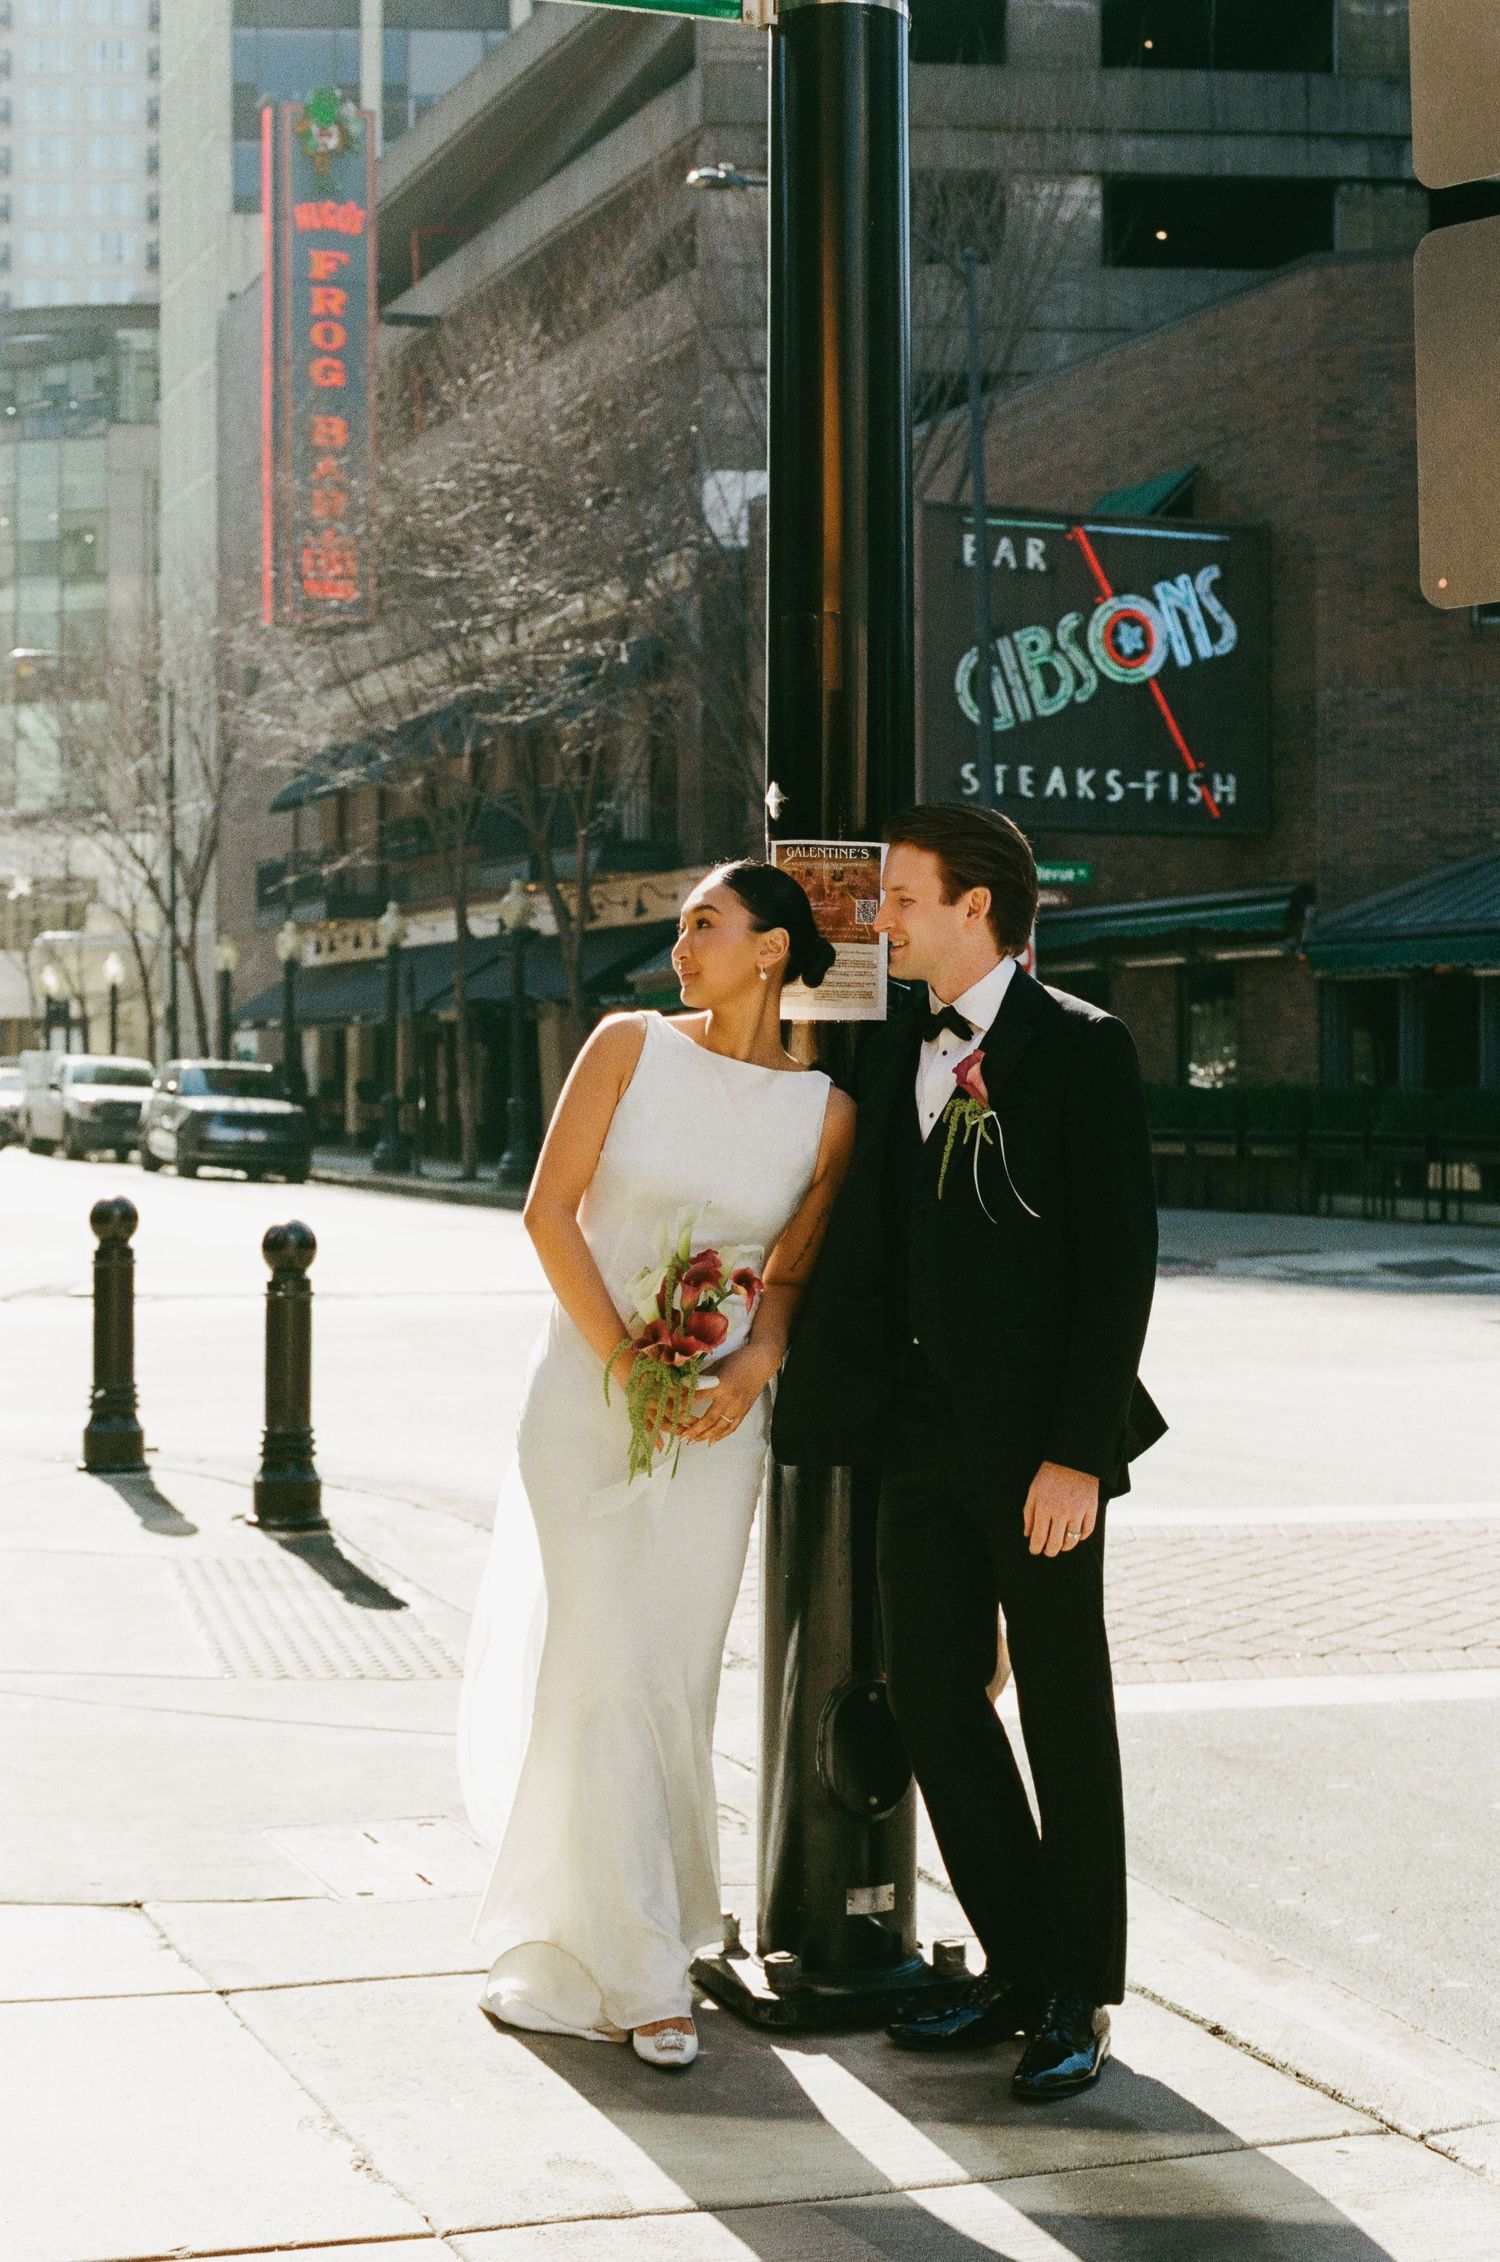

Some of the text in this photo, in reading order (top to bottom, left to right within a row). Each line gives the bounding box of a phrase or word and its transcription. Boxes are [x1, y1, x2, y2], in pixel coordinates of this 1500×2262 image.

[308, 248, 351, 388] FROG
[955, 564, 1238, 731] GIBSONS
[785, 847, 869, 861] GALENTINE'S
